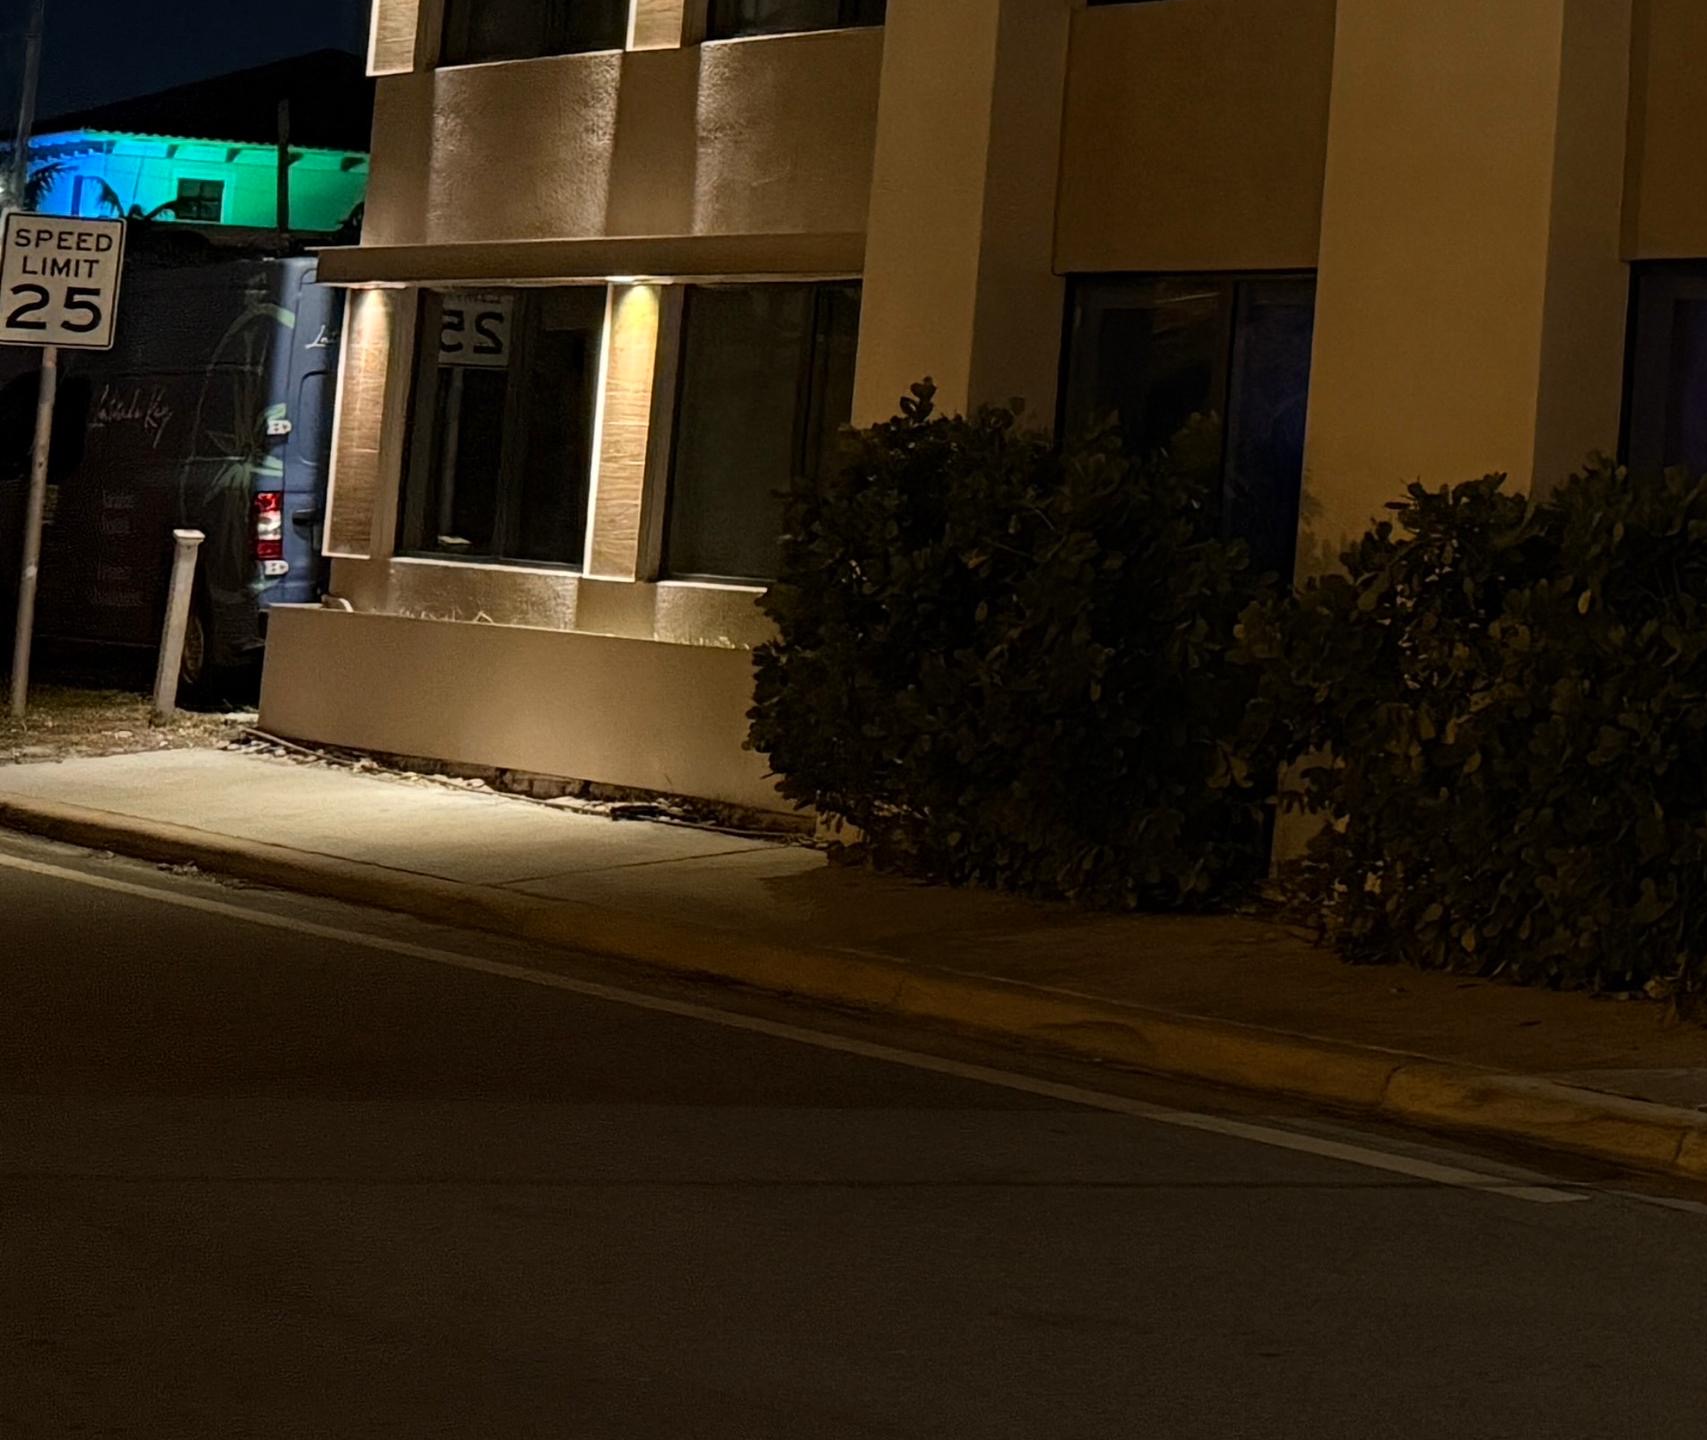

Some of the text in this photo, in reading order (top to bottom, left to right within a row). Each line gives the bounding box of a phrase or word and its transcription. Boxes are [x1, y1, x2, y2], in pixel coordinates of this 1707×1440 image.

[14, 228, 113, 252] SPEED
[21, 255, 100, 278] LIMIT
[5, 283, 103, 333] 25
